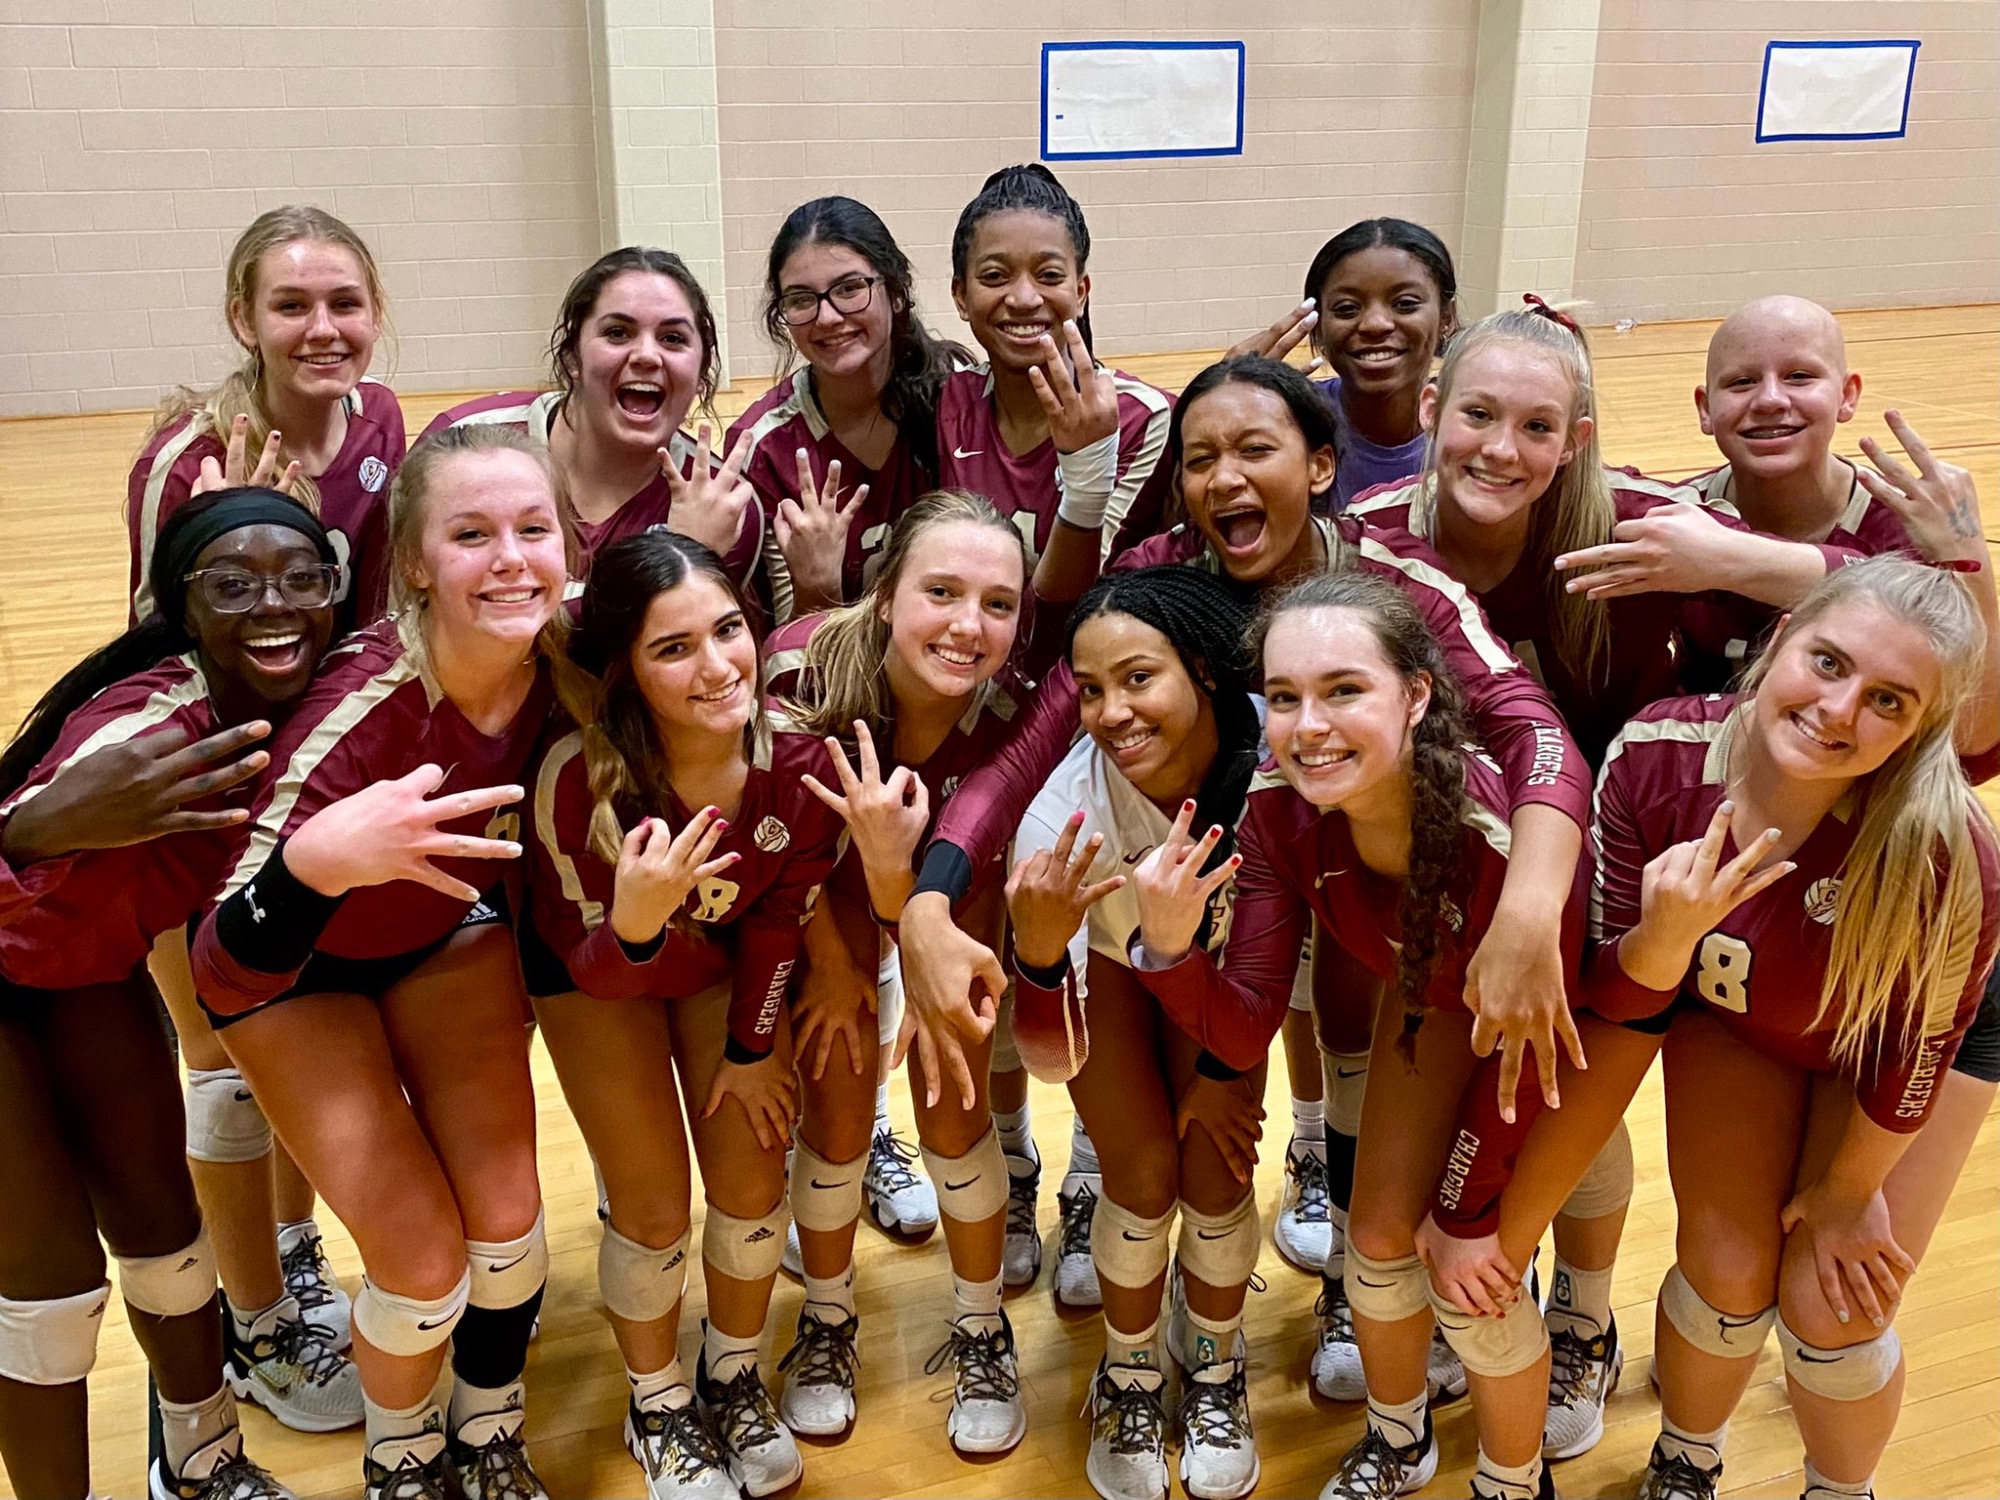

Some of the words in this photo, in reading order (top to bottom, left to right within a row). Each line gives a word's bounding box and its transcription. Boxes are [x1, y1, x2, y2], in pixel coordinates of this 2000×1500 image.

[1527, 720, 1565, 786] HARGERS
[753, 958, 796, 1035] CHARGERS
[1697, 932, 1752, 1014] 8
